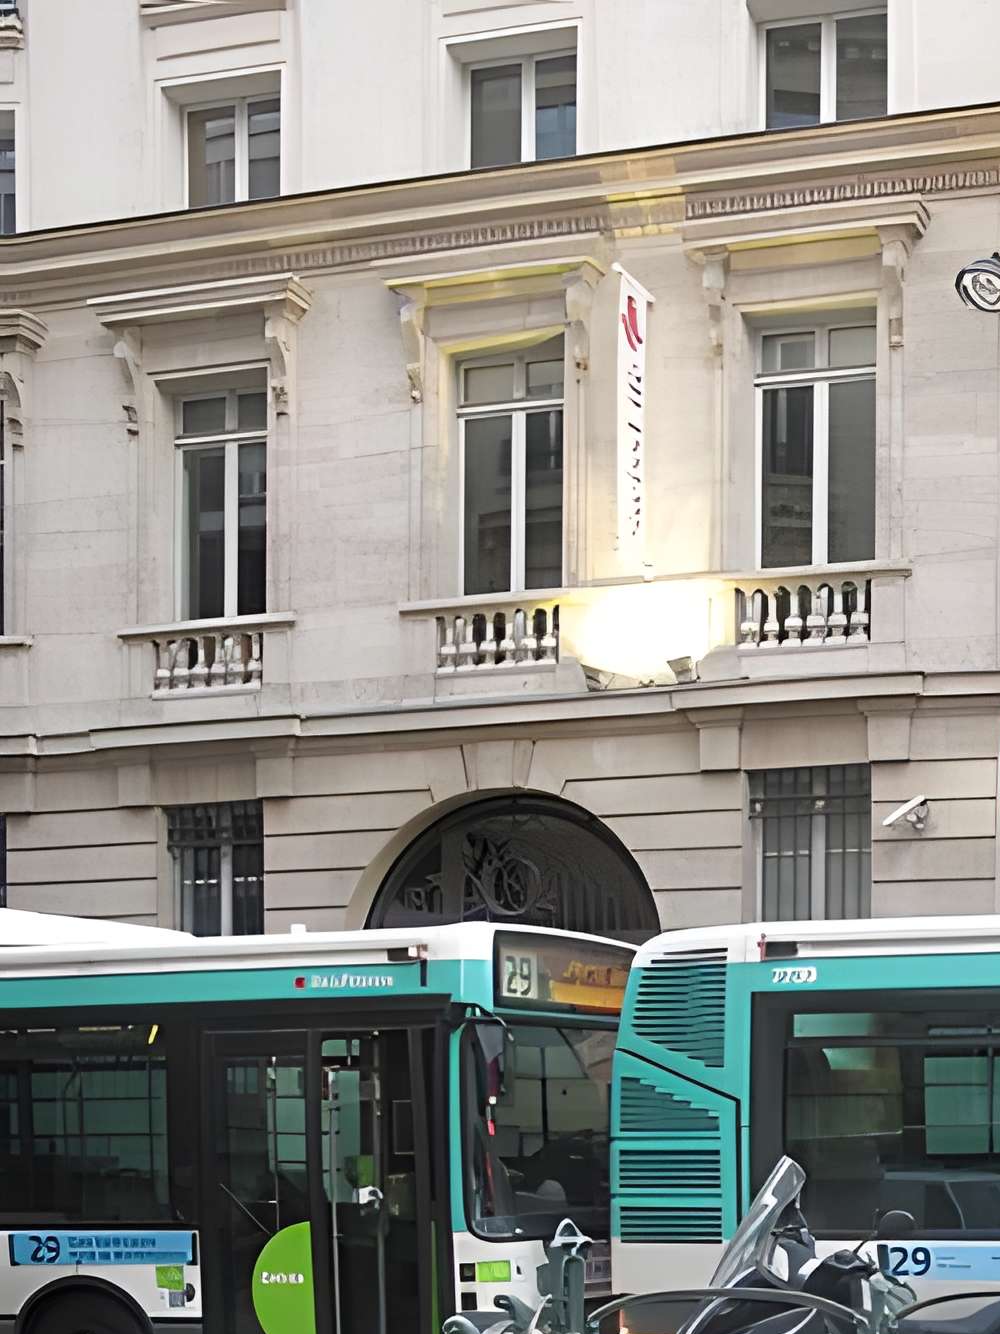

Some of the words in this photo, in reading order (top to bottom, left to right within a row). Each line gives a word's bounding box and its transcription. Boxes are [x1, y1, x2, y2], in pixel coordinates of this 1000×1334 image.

[505, 955, 532, 996] 29
[28, 1235, 61, 1264] 29
[889, 1246, 932, 1277] 29
